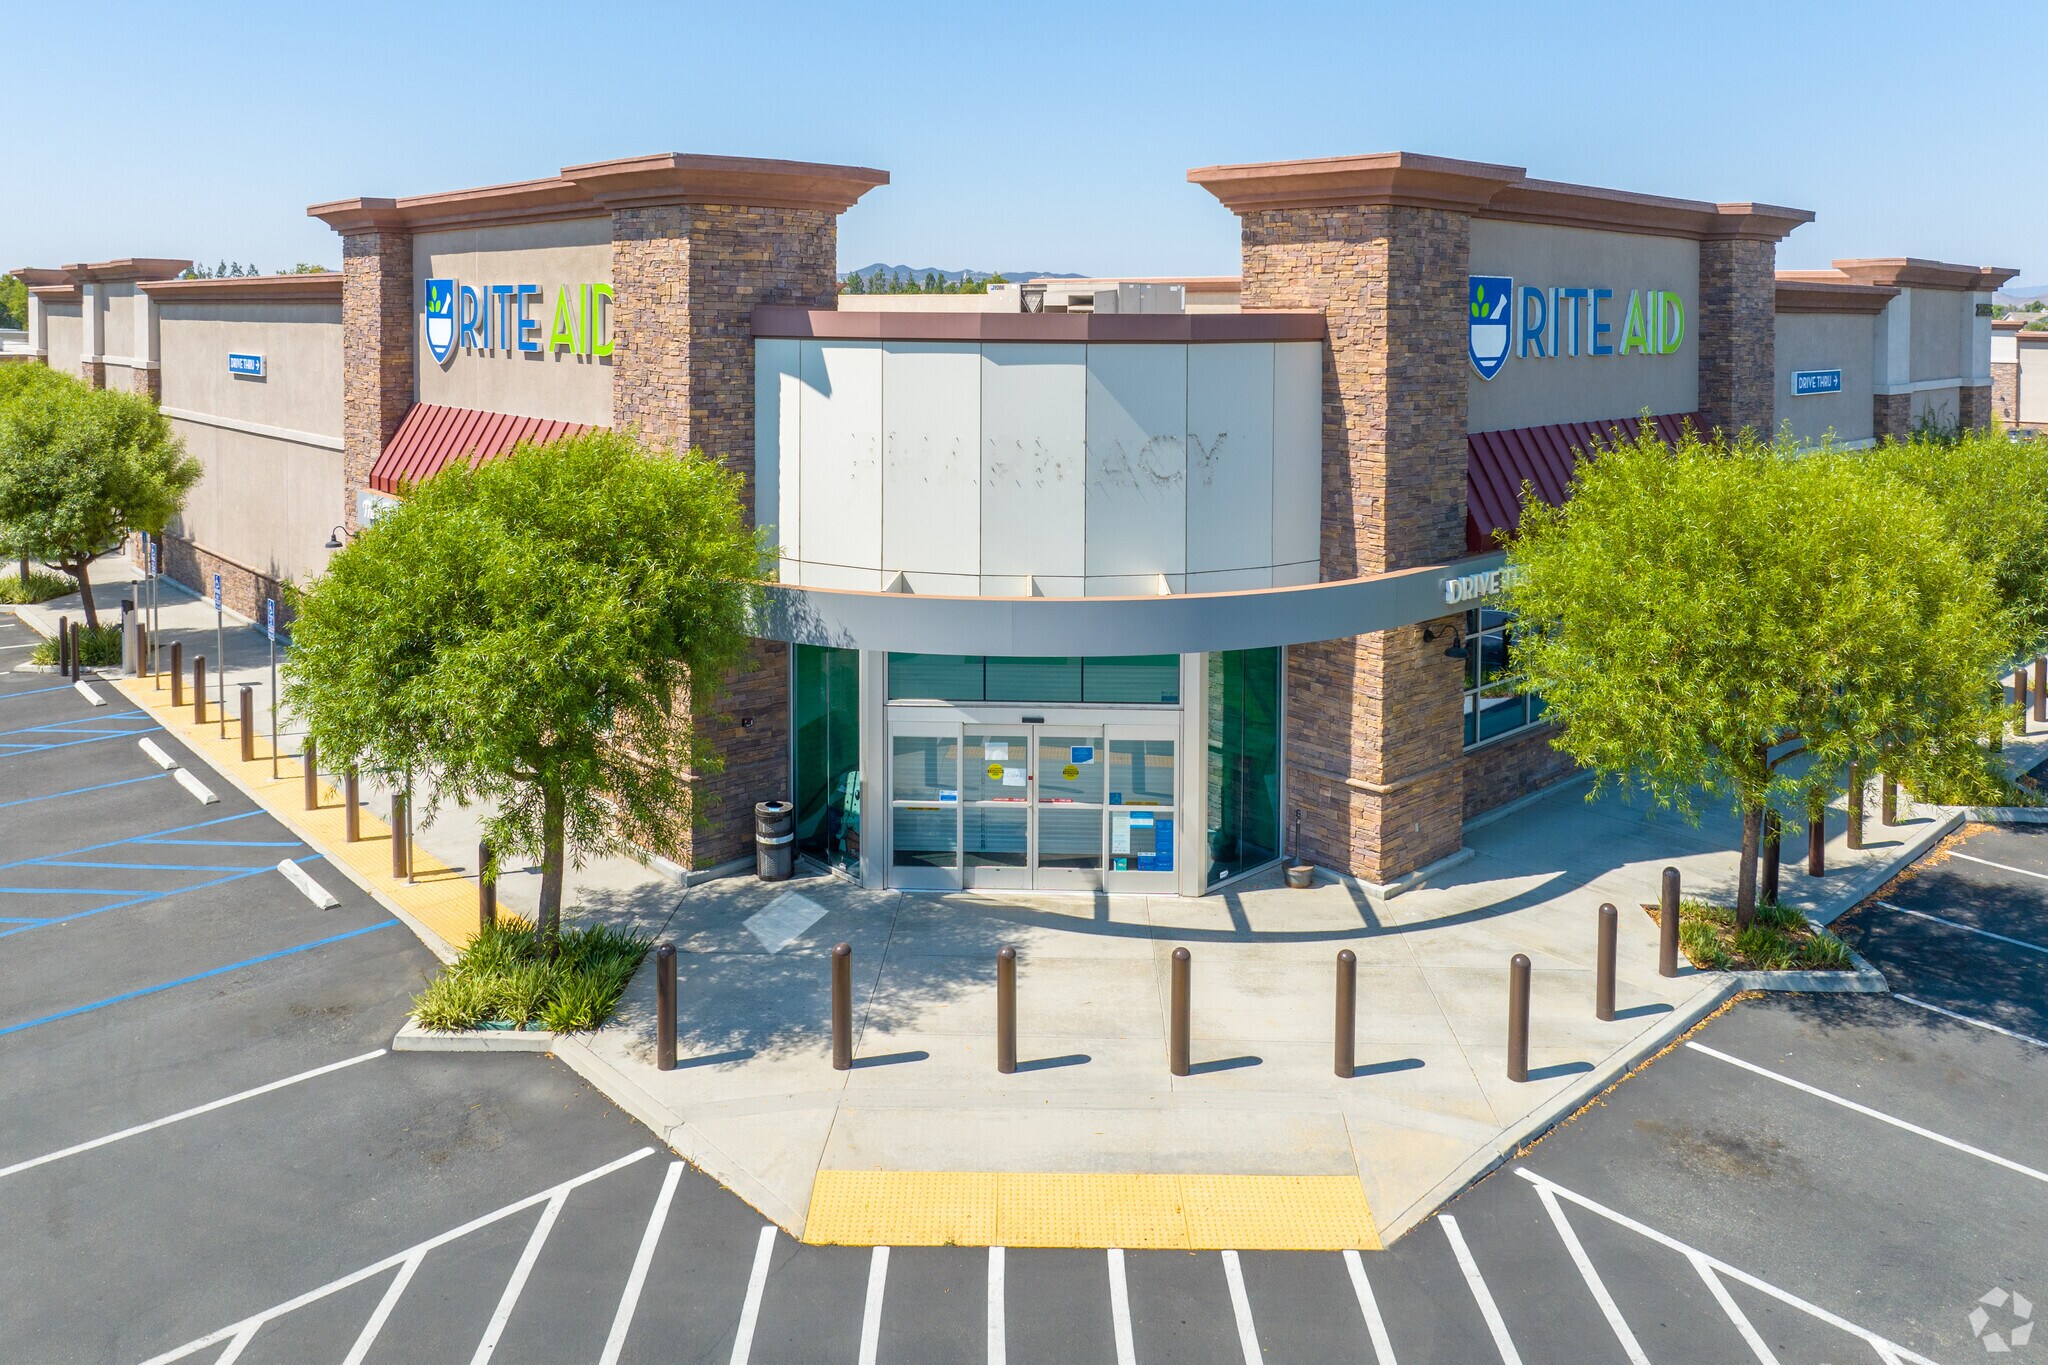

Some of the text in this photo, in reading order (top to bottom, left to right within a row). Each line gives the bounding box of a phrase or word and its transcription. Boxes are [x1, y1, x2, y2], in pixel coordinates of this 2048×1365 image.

[460, 283, 615, 356] RITE AID
[1516, 286, 1685, 358] RITE AID
[230, 357, 244, 369] DRIVE
[1798, 375, 1832, 389] DRIVE THRU
[1445, 568, 1501, 604] DRIVE
